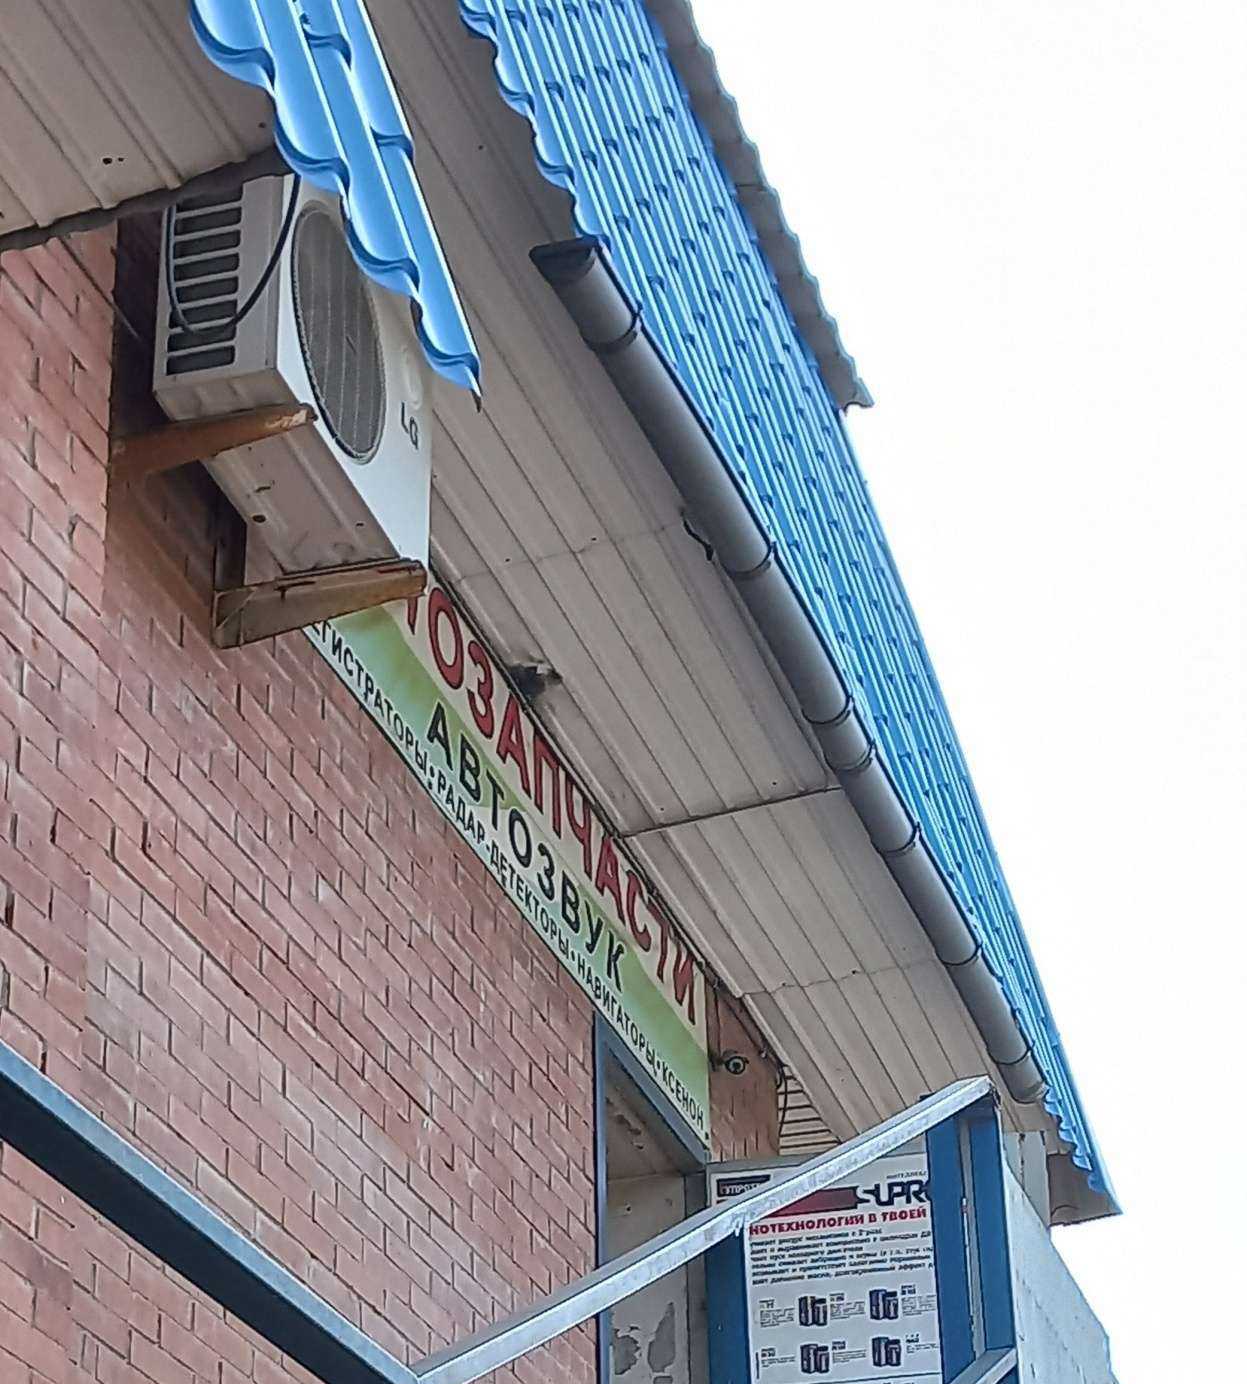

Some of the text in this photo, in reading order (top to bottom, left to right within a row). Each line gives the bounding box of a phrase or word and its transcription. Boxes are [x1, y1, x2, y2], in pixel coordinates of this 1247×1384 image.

[311, 621, 428, 776] ГИСТРАТОРЫ
[427, 702, 625, 992] АВТОЗВУК
[857, 1180, 928, 1206] SUPR
